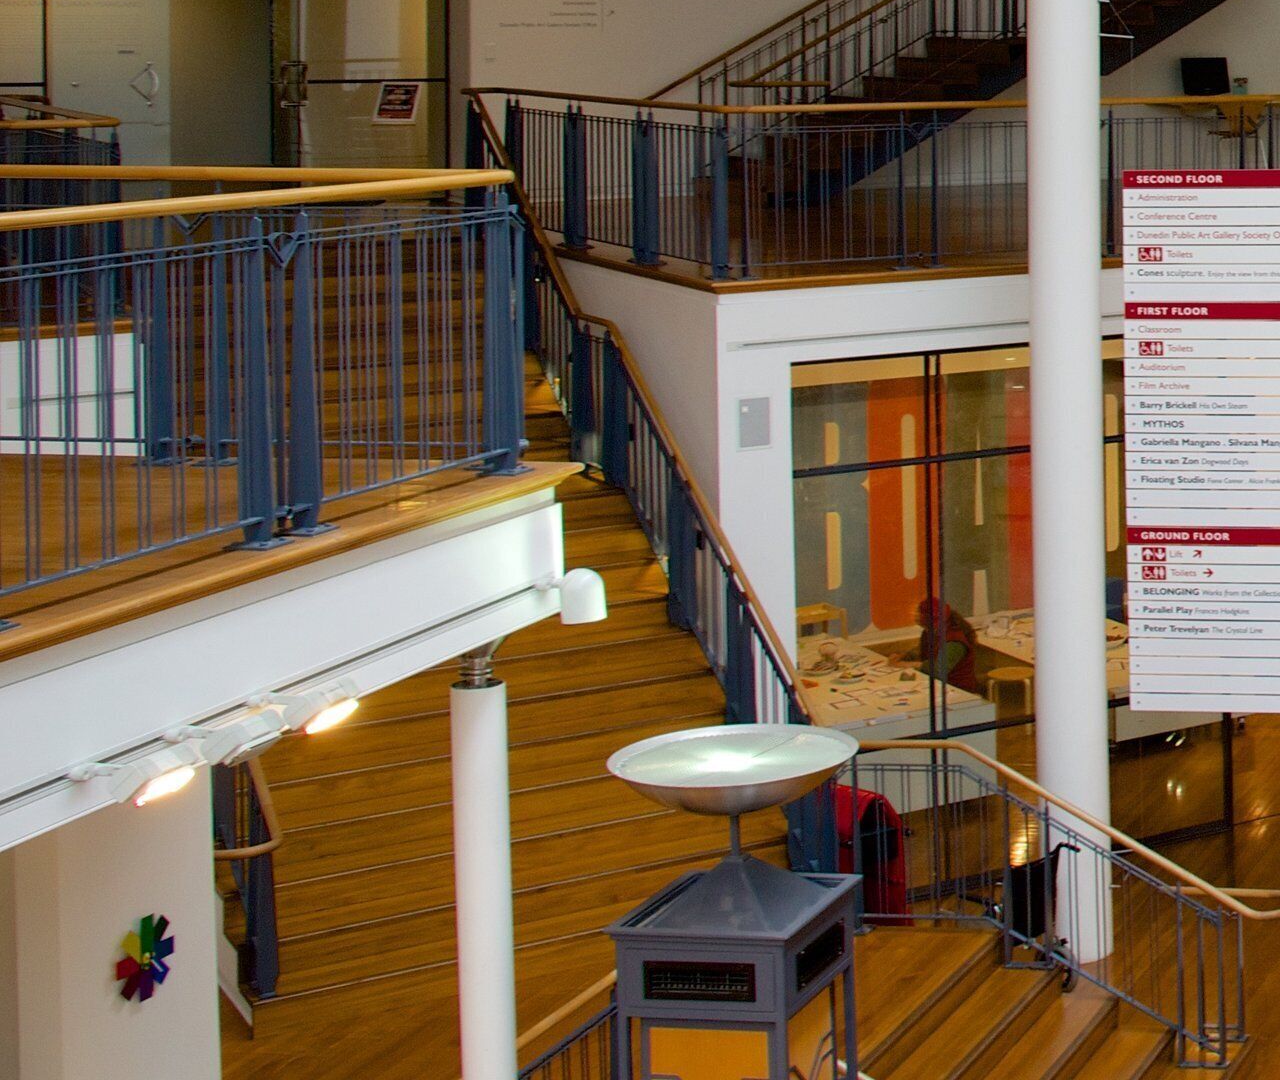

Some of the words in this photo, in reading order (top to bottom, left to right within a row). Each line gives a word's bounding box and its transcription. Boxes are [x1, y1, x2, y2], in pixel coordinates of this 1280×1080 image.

[1136, 175, 1183, 185] SECOND
[1186, 175, 1224, 184] FLOOR
[1138, 194, 1199, 202] Administration
[1137, 213, 1186, 221] Conference
[1188, 213, 1218, 221] Centre
[1137, 232, 1170, 240] Dunedin
[1172, 232, 1196, 240] Public
[1198, 232, 1211, 240] Art
[1213, 232, 1241, 242] Gallery
[1243, 232, 1271, 242] Society
[1167, 251, 1194, 259] Toilets
[1138, 270, 1165, 278] Cones
[1137, 307, 1169, 316] FIRST
[1171, 307, 1209, 316] FLOOR
[1168, 345, 1194, 353] Toilets
[1138, 364, 1186, 372] Auditorium
[1139, 383, 1157, 391] Film
[1159, 383, 1191, 391] Archive
[1140, 402, 1163, 411] Barry
[1165, 402, 1197, 410] Brickell
[1143, 421, 1185, 429] MYTHOS
[1141, 439, 1180, 447] Gabriella
[1182, 440, 1221, 449] Mangano
[1182, 458, 1200, 466] Zon
[1141, 476, 1175, 486] Floating
[1177, 476, 1206, 484] Studio
[1141, 532, 1190, 541] GROUND
[1193, 533, 1230, 542] FLOOR
[1169, 551, 1184, 559] Lift
[1171, 569, 1197, 578] Toilets
[1143, 588, 1201, 597] BELONGING
[1176, 607, 1194, 616] Play
[1144, 625, 1168, 633] Peter
[1169, 626, 1210, 635] Trevelyan
